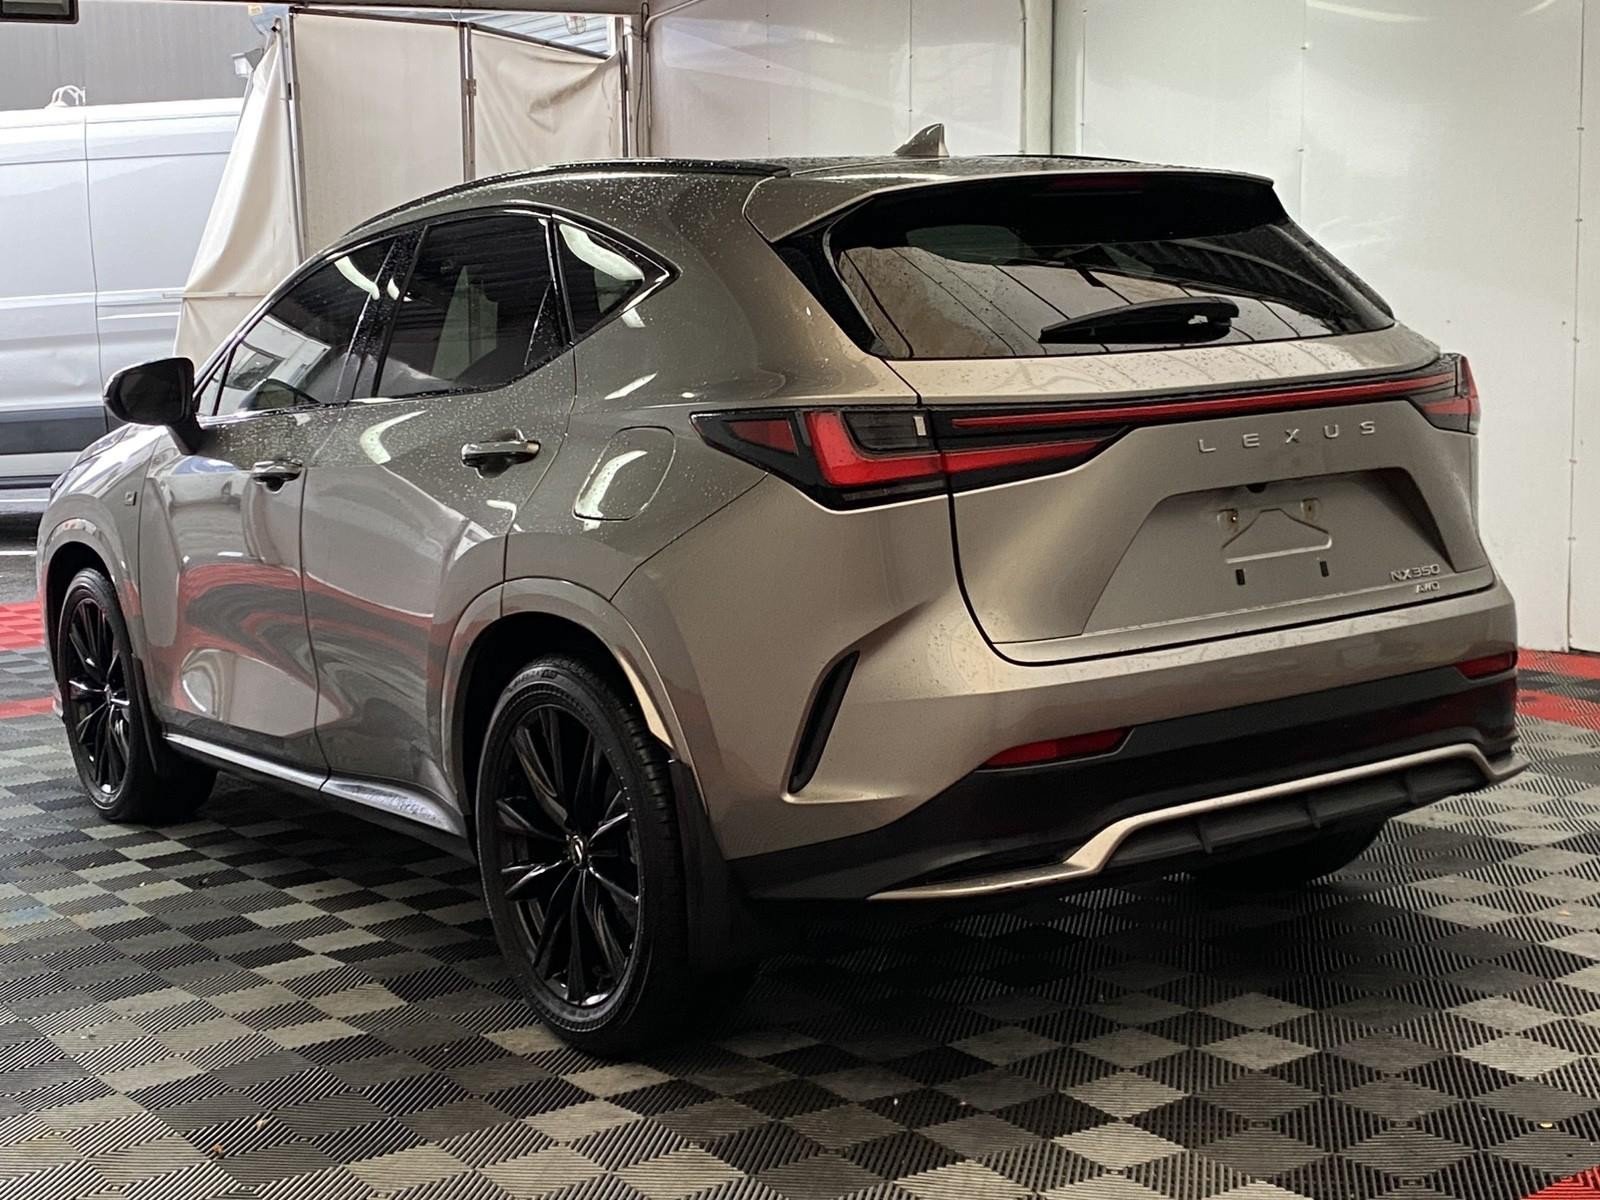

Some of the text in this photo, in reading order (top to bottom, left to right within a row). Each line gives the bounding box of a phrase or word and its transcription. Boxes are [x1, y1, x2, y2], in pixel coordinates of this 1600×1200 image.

[1198, 420, 1377, 453] LEXUS
[1390, 563, 1441, 582] NX350
[1415, 581, 1441, 594] AWD
